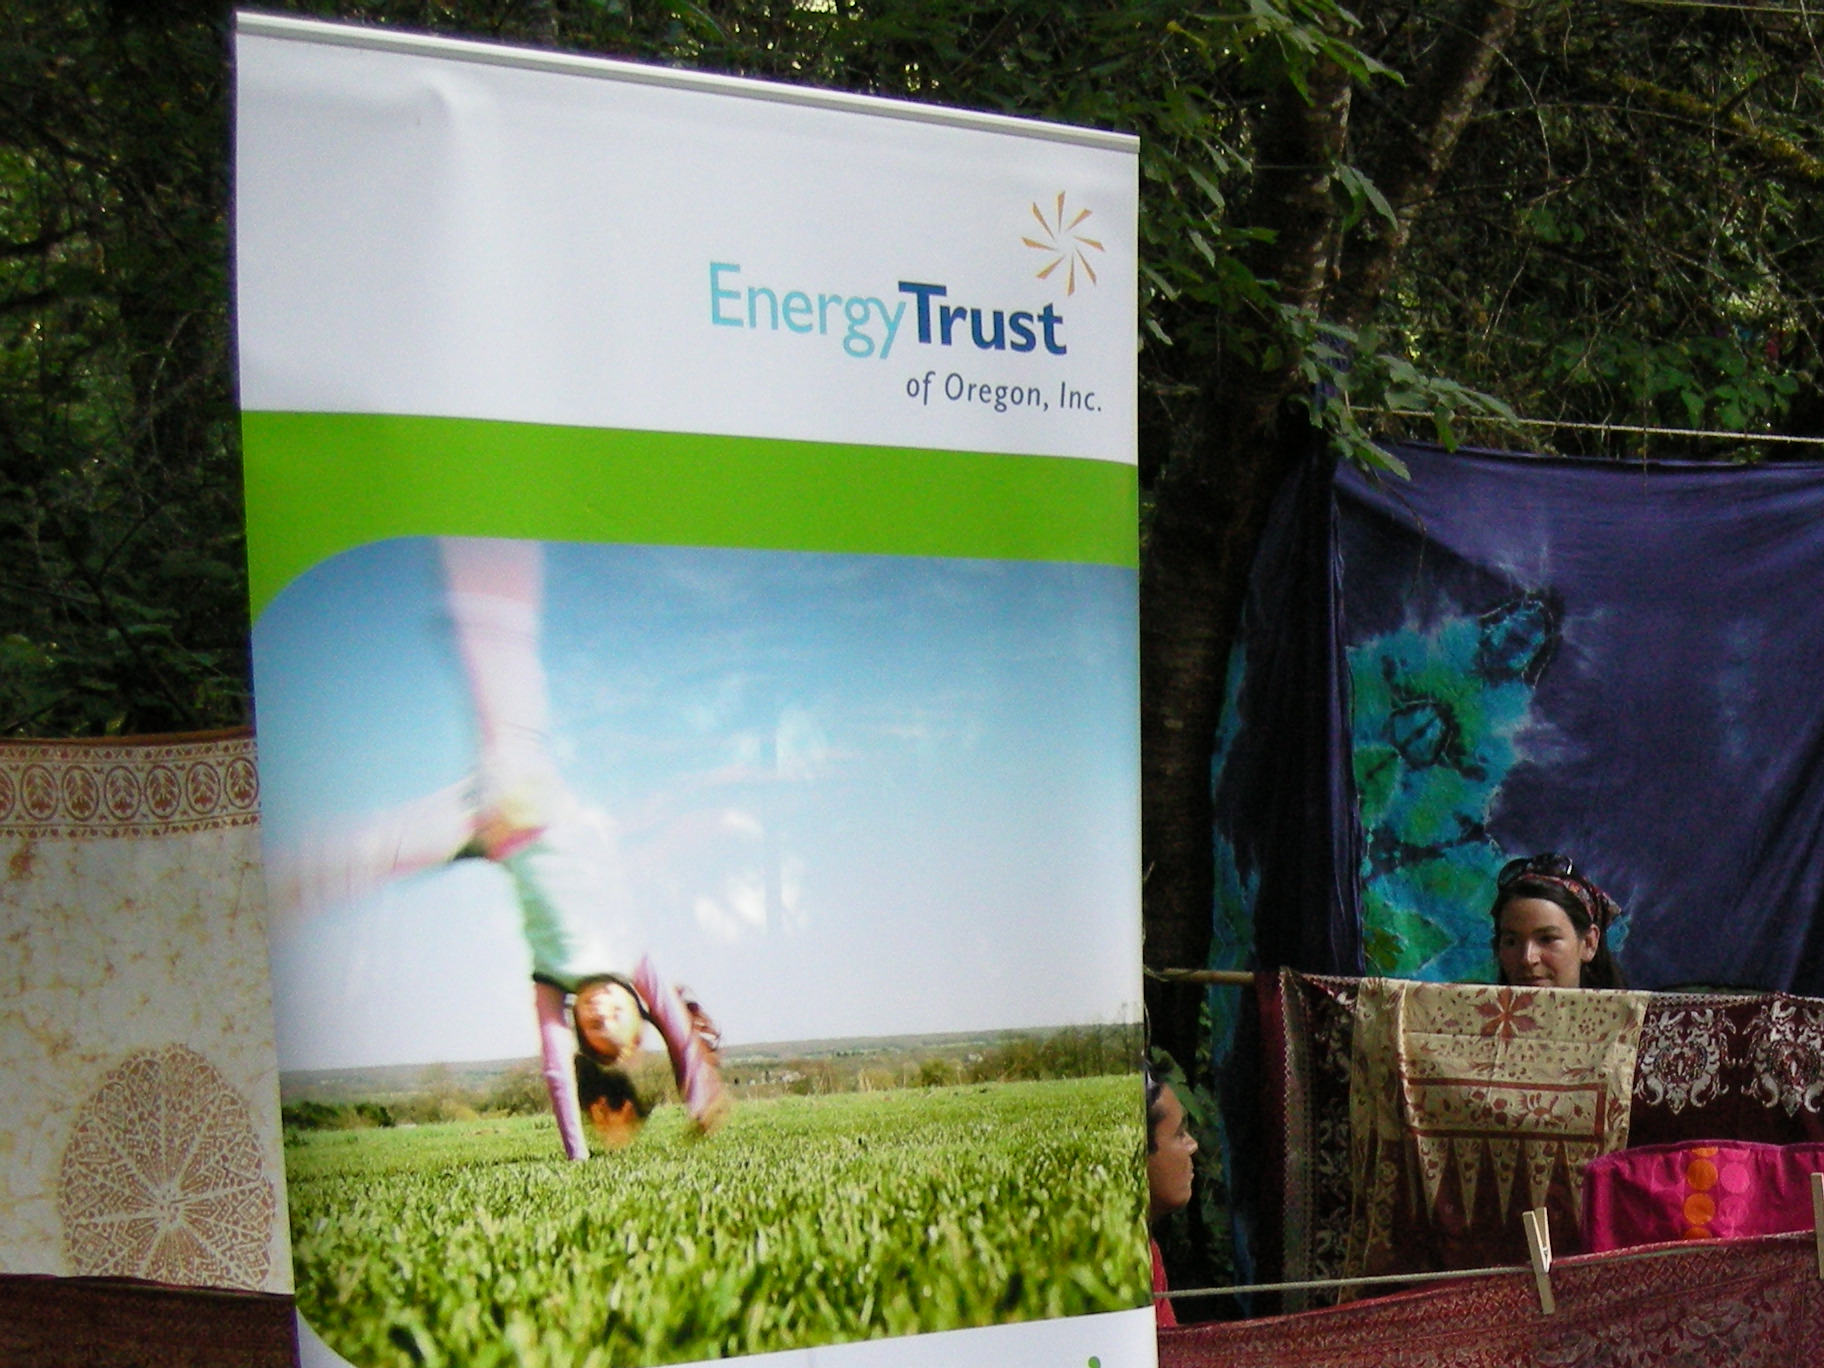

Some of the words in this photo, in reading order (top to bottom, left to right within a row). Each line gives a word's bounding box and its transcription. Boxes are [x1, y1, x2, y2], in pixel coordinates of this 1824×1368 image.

[710, 259, 1067, 359] EnergyTrust
[907, 371, 936, 405] of
[944, 373, 1049, 413] Oregon,
[1061, 381, 1101, 411] Inc.
